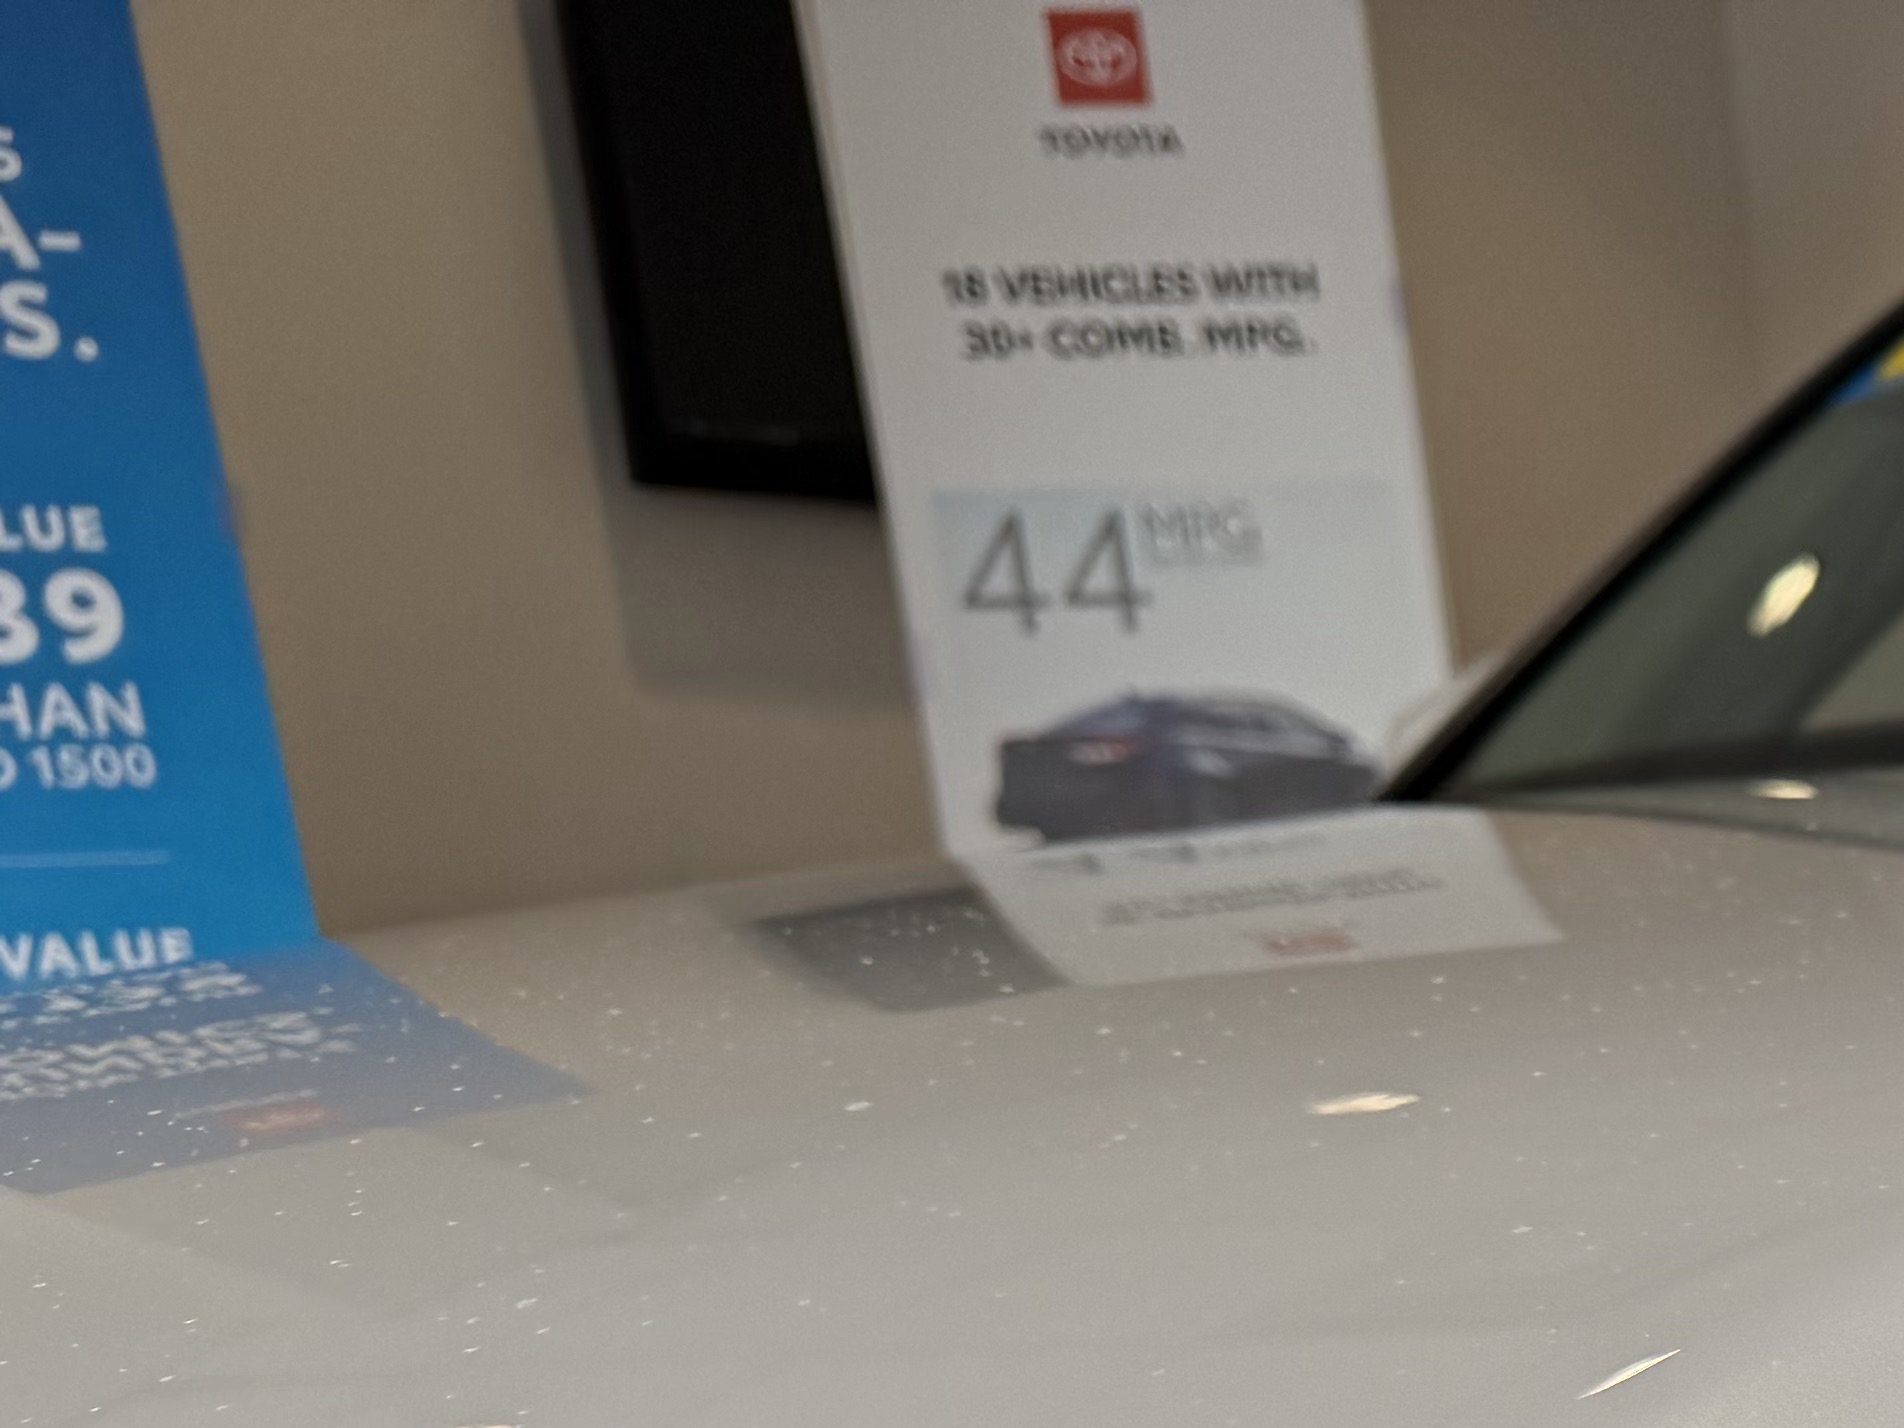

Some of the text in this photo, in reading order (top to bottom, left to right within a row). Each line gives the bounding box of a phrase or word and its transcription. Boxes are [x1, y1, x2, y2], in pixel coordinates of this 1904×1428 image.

[1037, 122, 1186, 160] TOYOTA
[994, 259, 1199, 304] VEHICLES
[1207, 257, 1319, 300] WITH
[961, 506, 1152, 637] 44
[28, 743, 157, 789] 1500
[0, 927, 194, 981] VALUE
